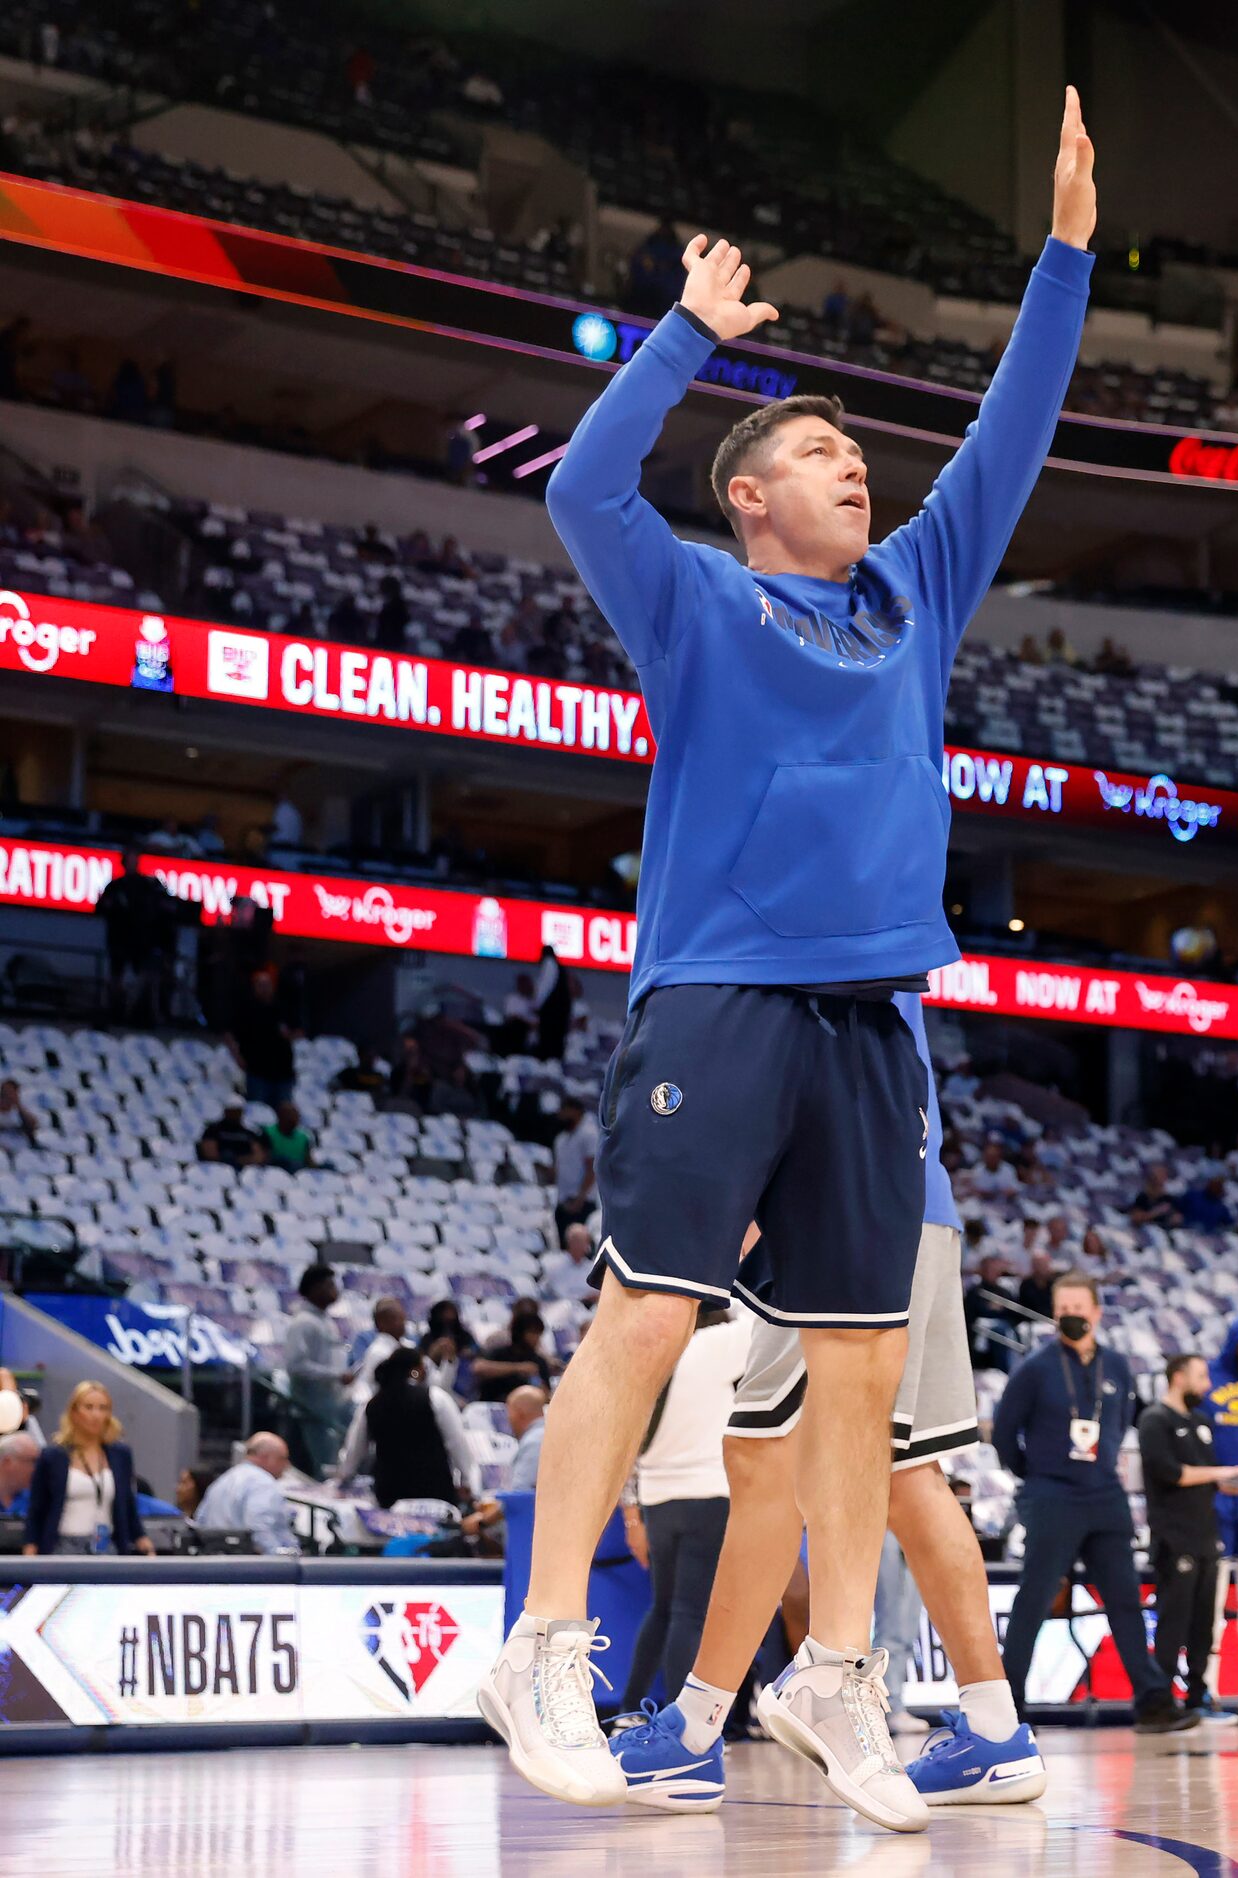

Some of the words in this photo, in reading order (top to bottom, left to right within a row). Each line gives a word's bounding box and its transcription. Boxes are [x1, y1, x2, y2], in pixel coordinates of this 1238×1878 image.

[280, 642, 442, 727] CLEAN.
[452, 669, 648, 757] HEALTHY.
[1022, 764, 1069, 813] AT
[351, 885, 437, 944] Kroger
[1015, 970, 1081, 1011] NOW
[1085, 978, 1120, 1016] AT
[119, 1614, 297, 1697] #NBA75
